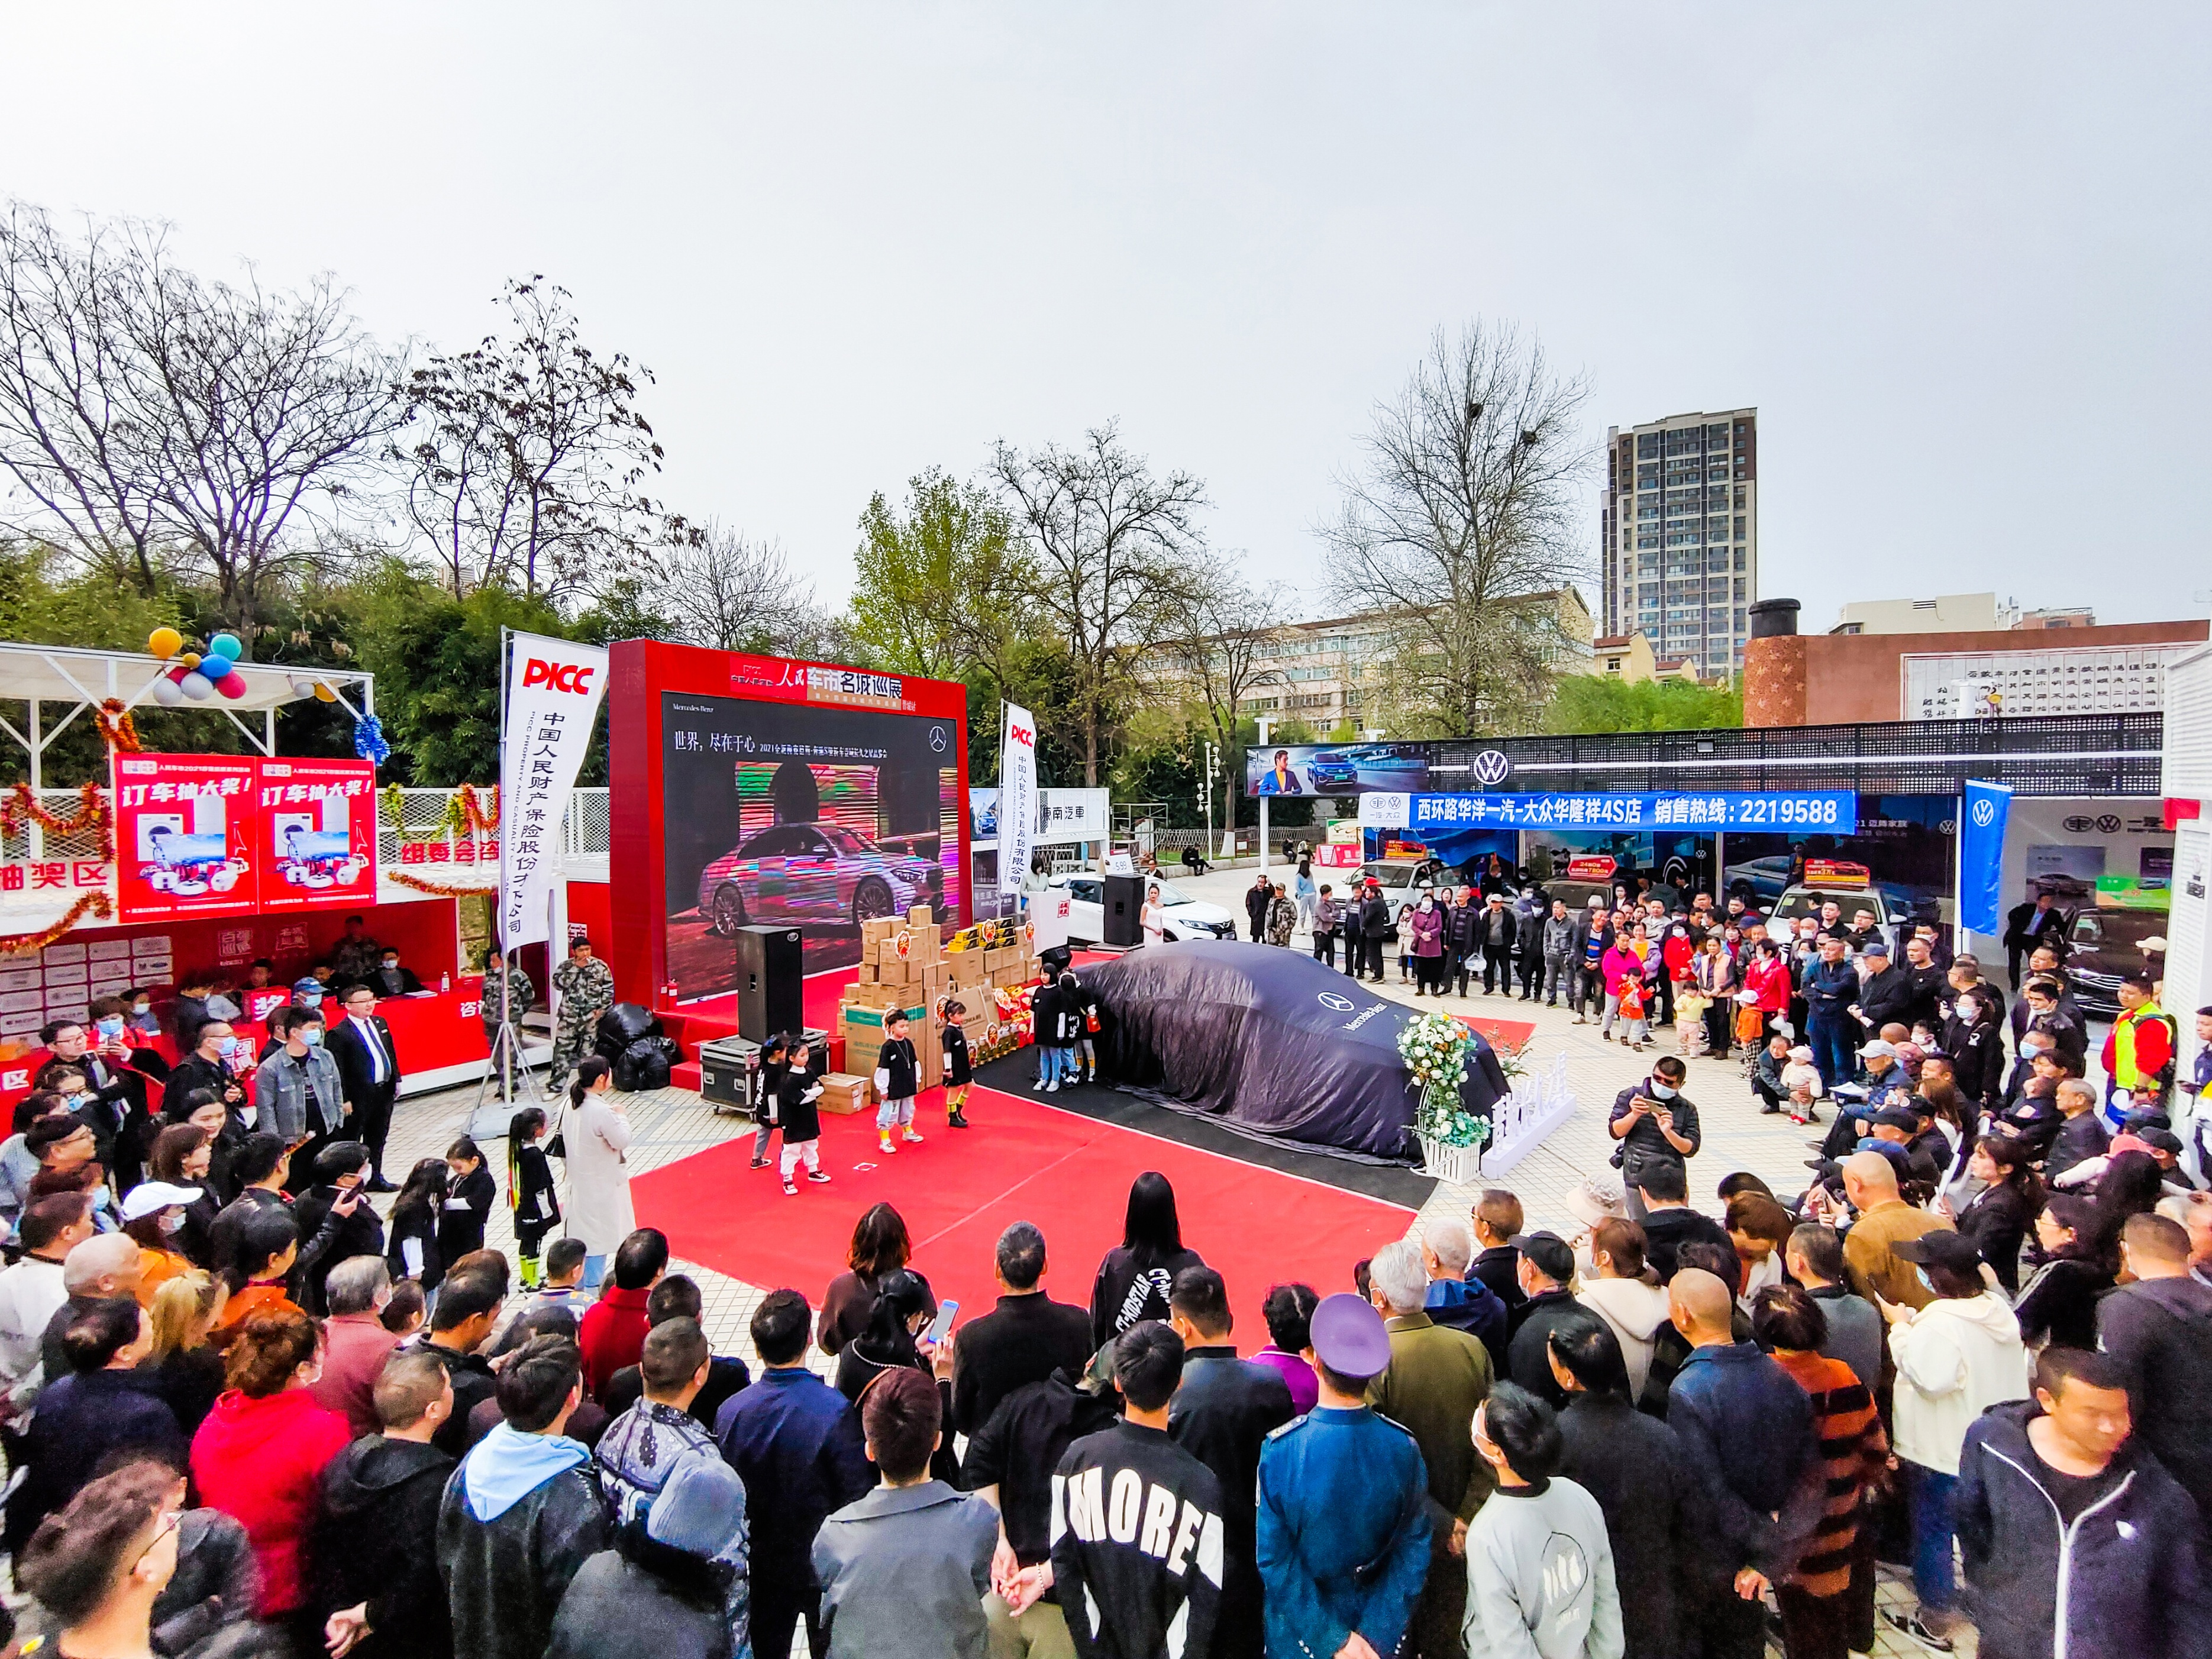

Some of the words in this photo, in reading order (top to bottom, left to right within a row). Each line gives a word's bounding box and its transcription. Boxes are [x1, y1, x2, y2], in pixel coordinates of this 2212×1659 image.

[522, 658, 595, 695] PICC
[673, 703, 713, 712] Mercedes-Benz
[1011, 724, 1033, 747] PICC
[518, 735, 530, 781] PROPERTY
[1417, 797, 1642, 824] 西环路华洋一汽-大众华隆祥4S店
[511, 806, 519, 852] CASUALTY
[460, 1002, 485, 1018] 咨
[1342, 1002, 1388, 1031] Mercedes-Benz
